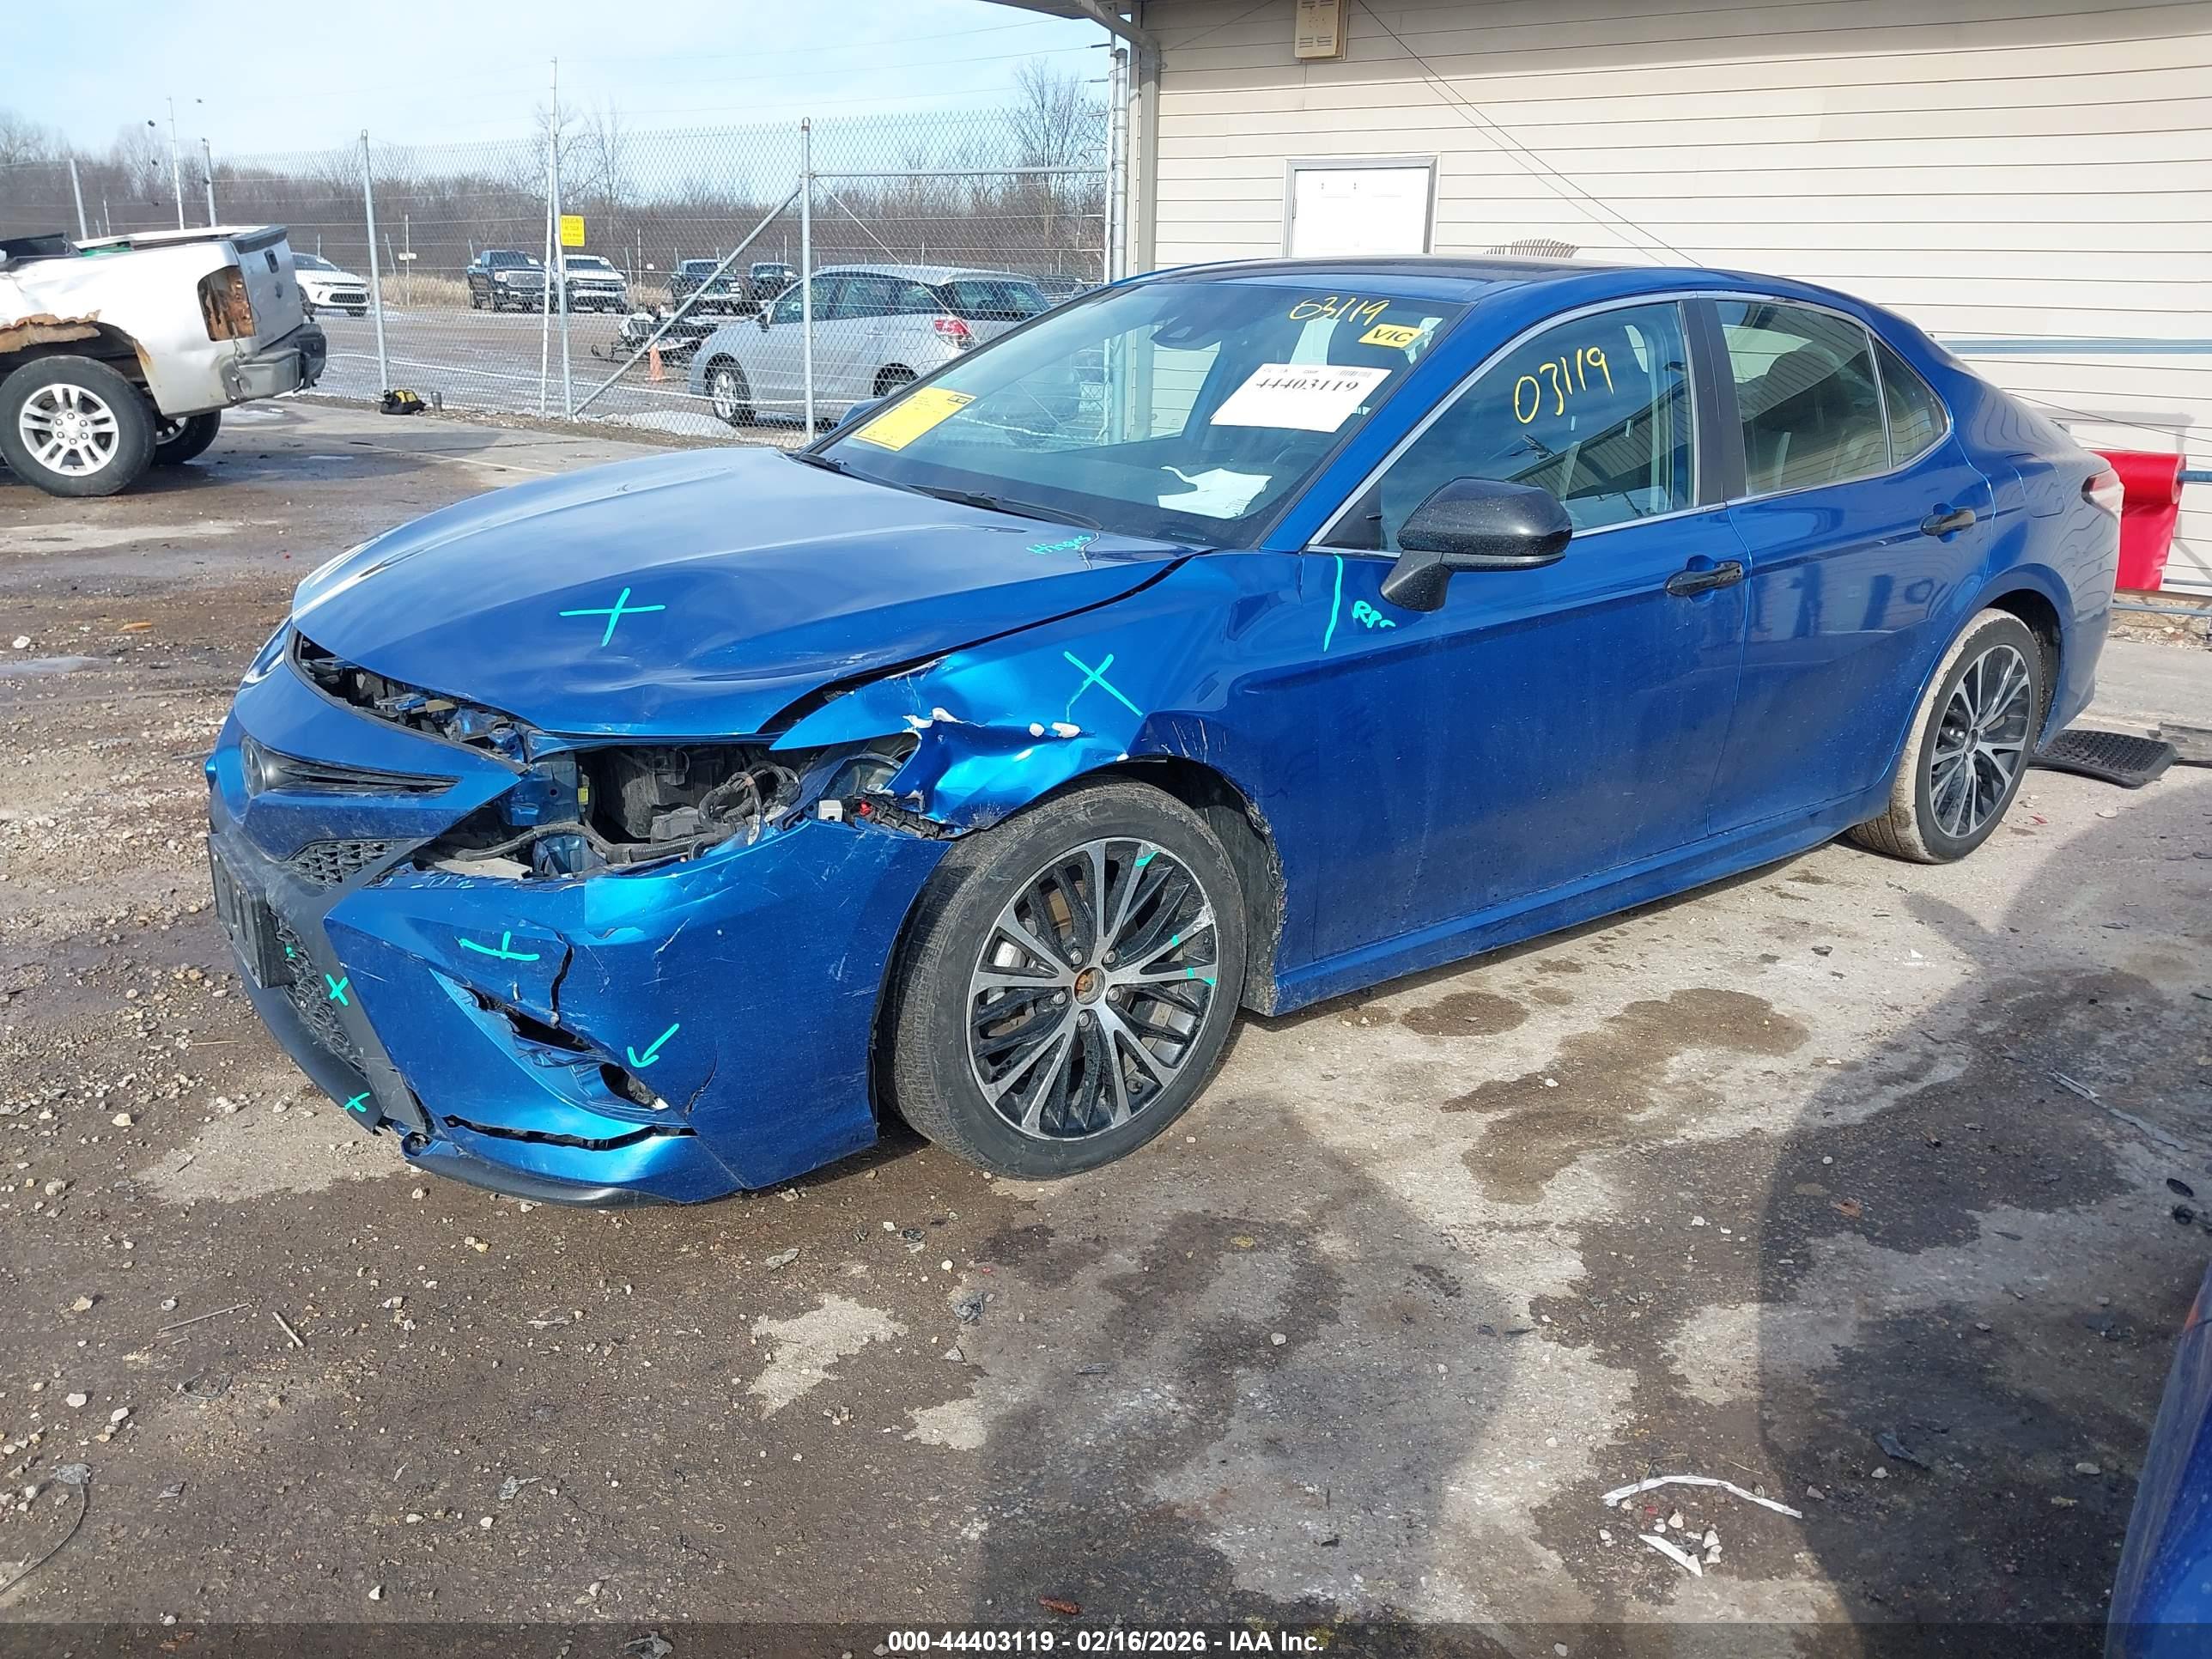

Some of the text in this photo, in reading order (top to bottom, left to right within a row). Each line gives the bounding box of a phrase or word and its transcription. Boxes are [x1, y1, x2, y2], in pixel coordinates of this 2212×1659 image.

[1373, 328, 1413, 343] VIC
[1255, 377, 1359, 392] 44403119
[1514, 346, 1614, 424] 03119
